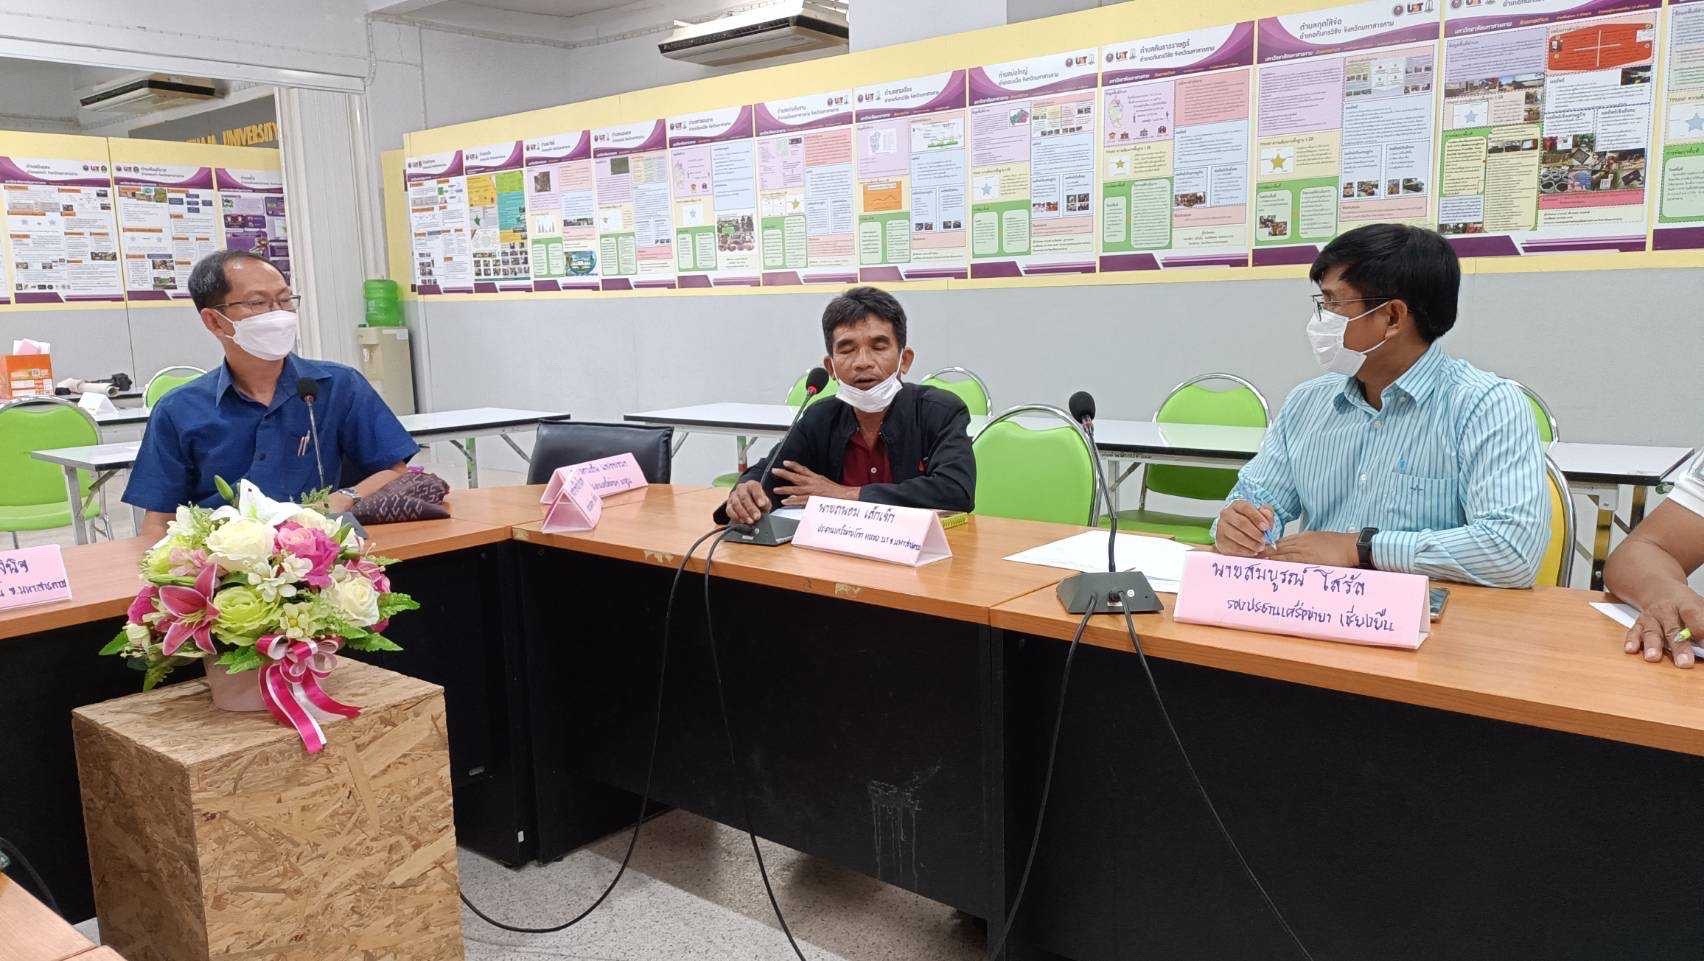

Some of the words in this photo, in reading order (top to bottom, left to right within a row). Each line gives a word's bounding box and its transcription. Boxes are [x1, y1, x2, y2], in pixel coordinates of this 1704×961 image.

[1212, 562, 1316, 592] นายสมบูรณ์
[1340, 605, 1394, 631] เชียงยืน
